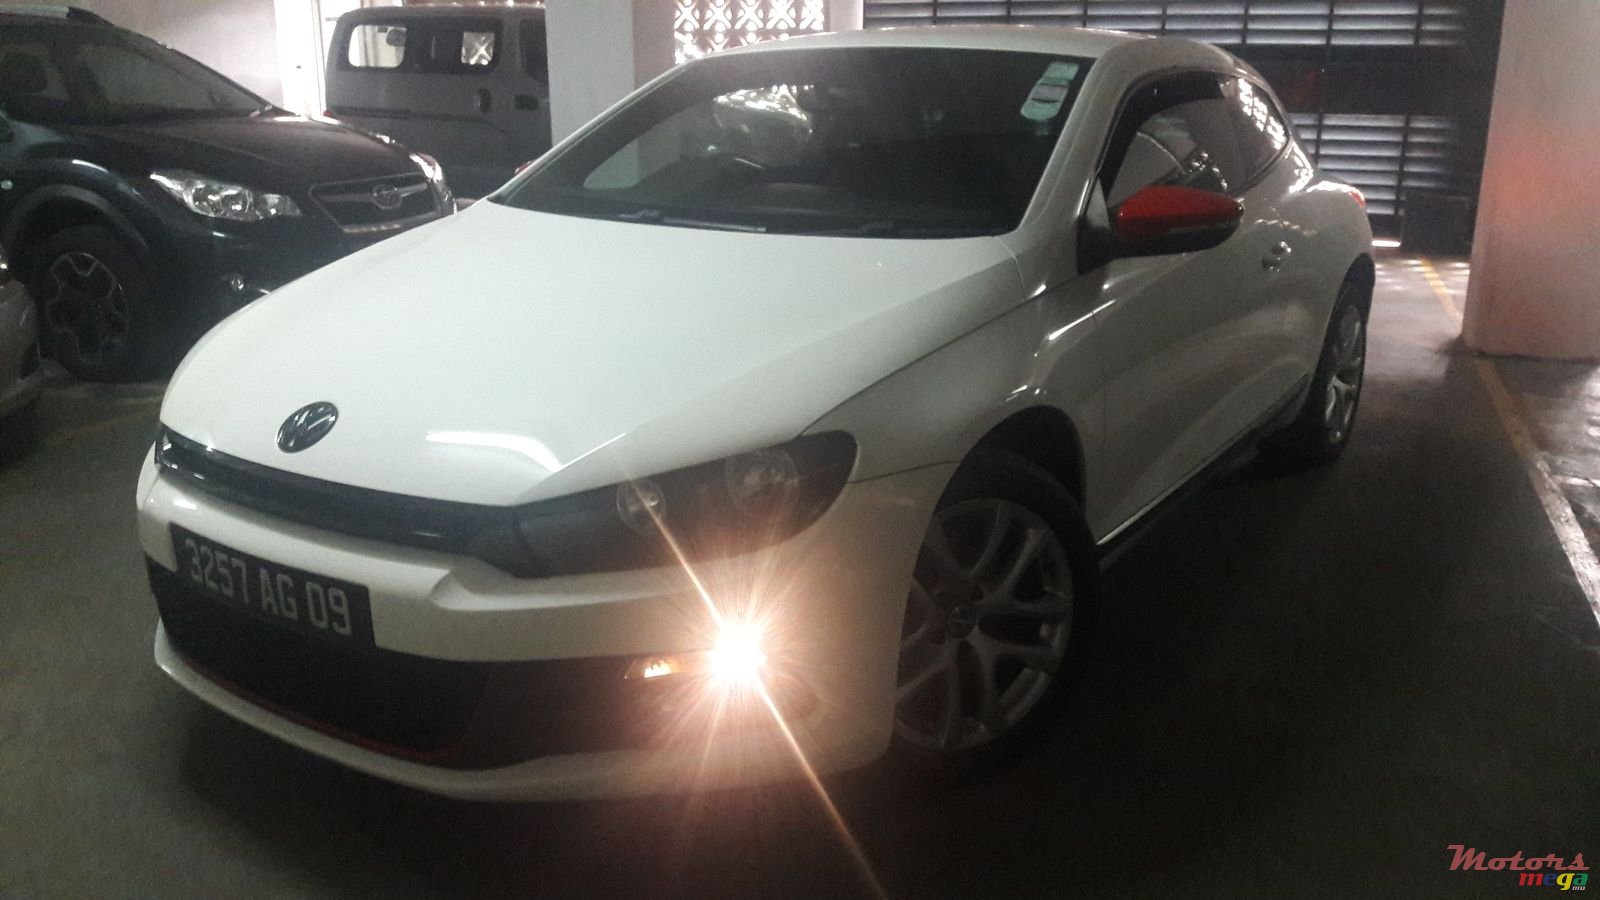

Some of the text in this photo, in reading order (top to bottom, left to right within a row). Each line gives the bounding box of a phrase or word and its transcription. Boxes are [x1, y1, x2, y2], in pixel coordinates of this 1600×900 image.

[184, 538, 351, 635] 3257 AG 09
